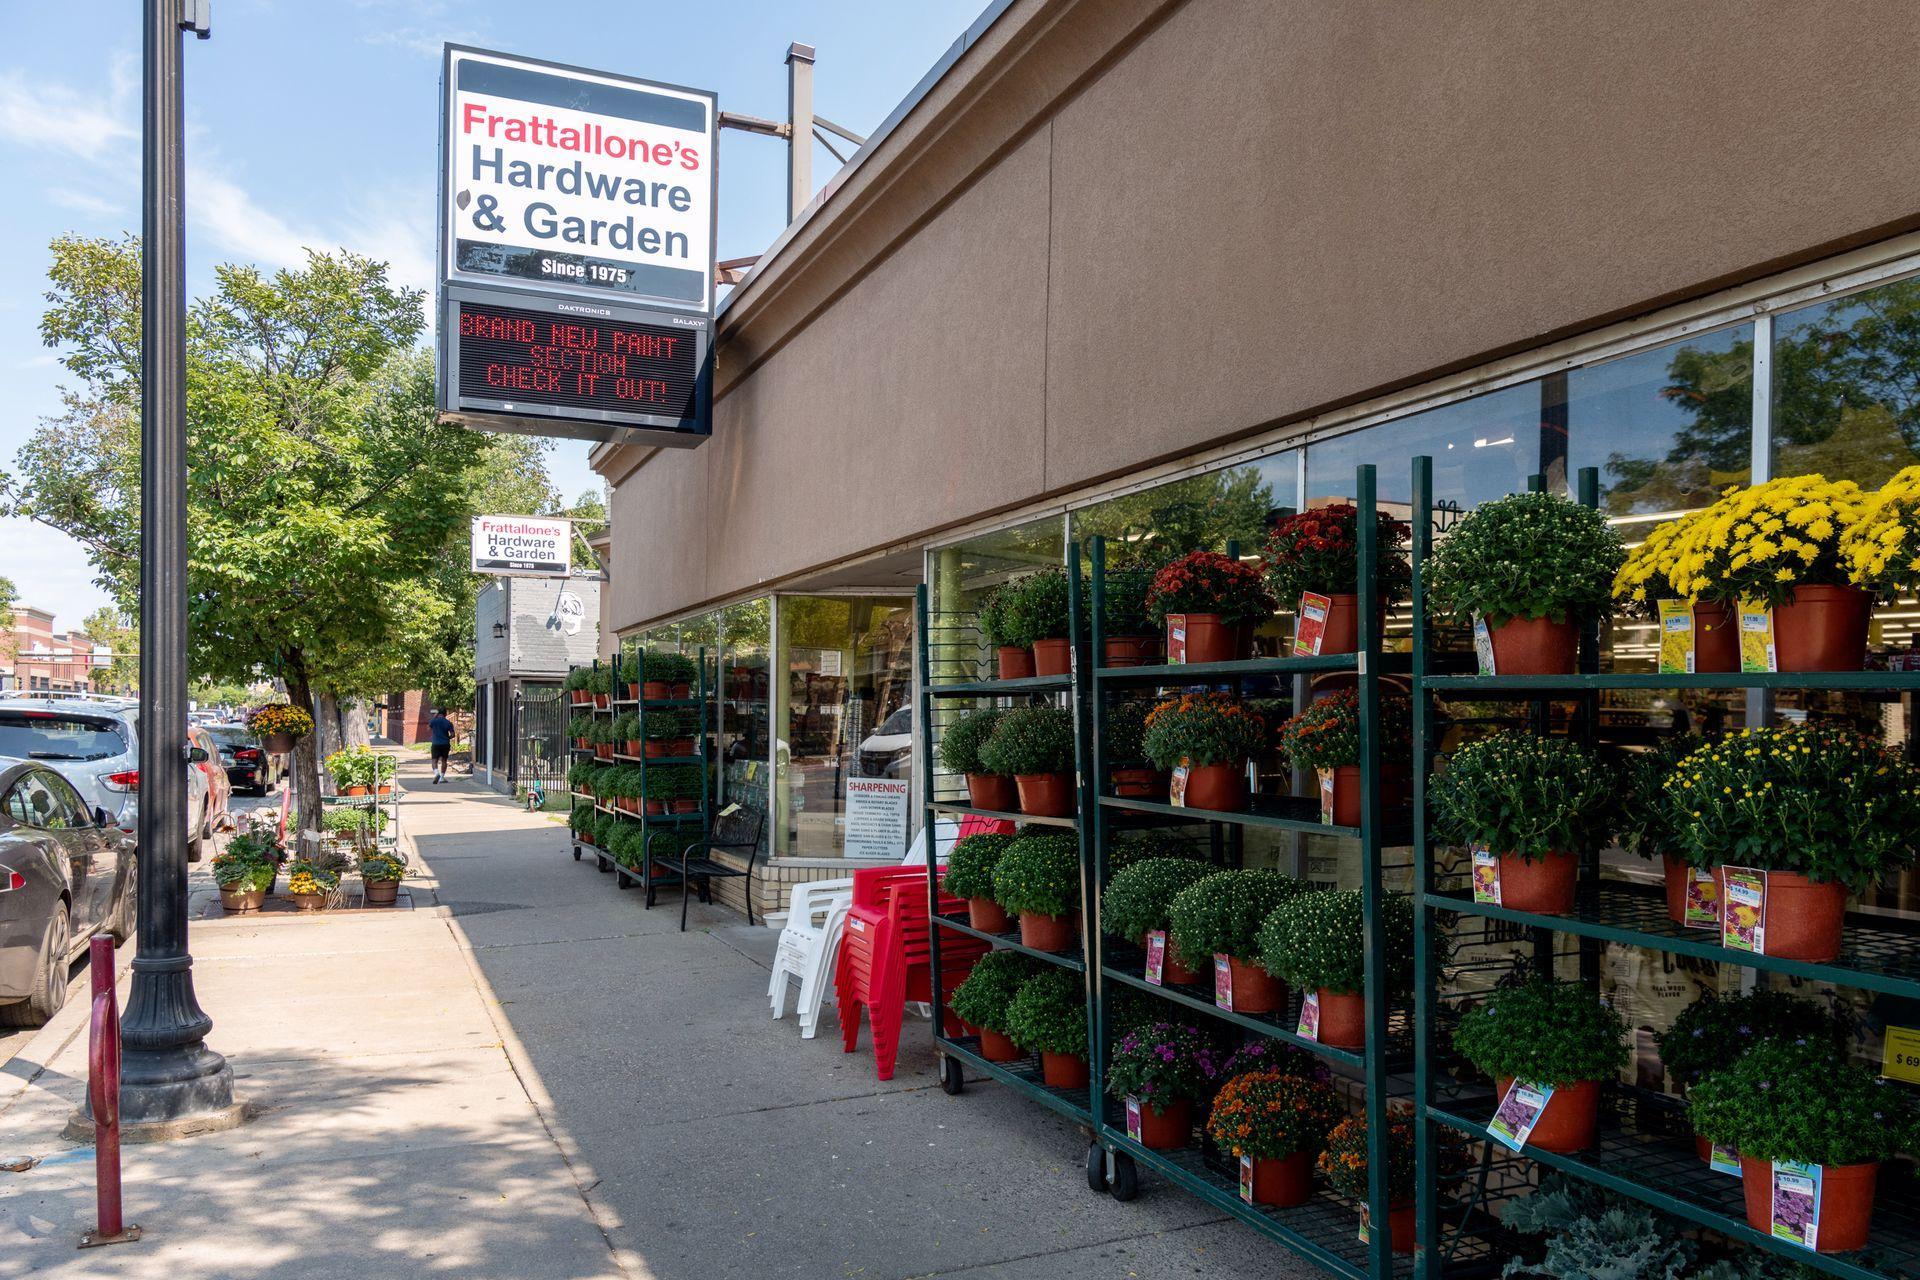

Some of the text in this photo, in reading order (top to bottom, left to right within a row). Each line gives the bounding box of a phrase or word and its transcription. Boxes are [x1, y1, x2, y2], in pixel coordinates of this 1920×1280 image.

[463, 103, 699, 171] Frattallone's
[472, 144, 691, 212] Hardware
[471, 193, 688, 258] & Garden
[541, 258, 627, 283] Since 1975
[558, 304, 611, 316] DAKTRONICS
[460, 313, 678, 358] BRAND NEW PAINT
[531, 345, 626, 376] SECTION
[488, 364, 666, 403] CHECK IT OUT!
[482, 521, 561, 536] Frattallone's
[488, 534, 556, 549] Hardware
[488, 545, 555, 560] & Garden
[848, 782, 906, 793] SHARPENING
[1896, 1053, 1903, 1064] $
